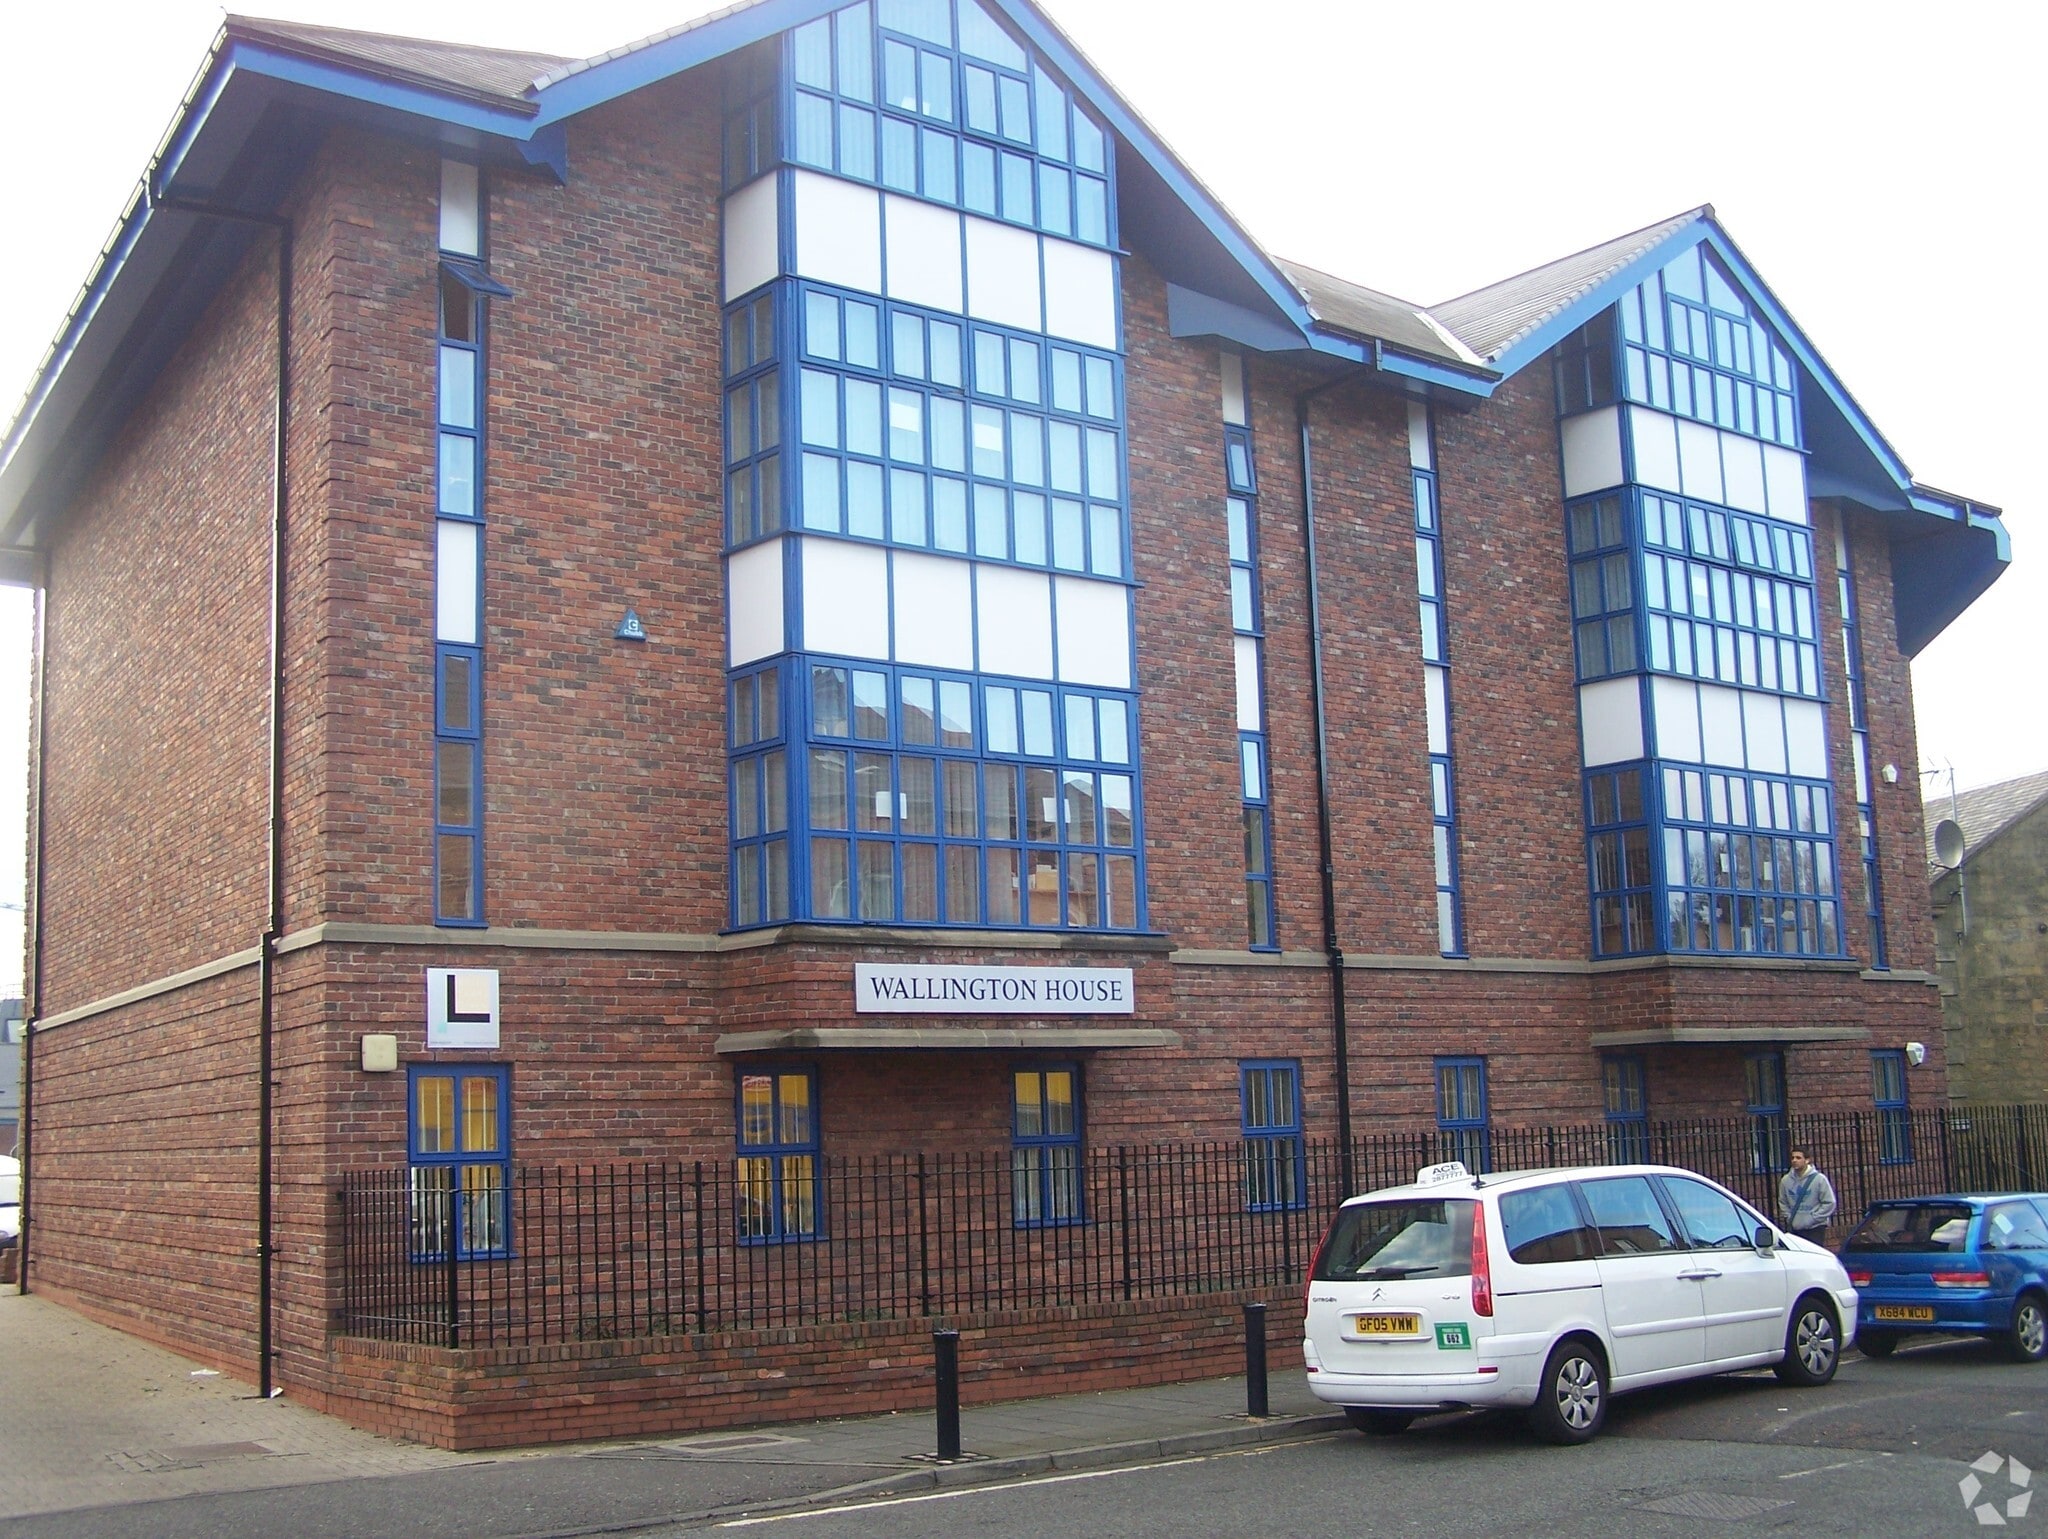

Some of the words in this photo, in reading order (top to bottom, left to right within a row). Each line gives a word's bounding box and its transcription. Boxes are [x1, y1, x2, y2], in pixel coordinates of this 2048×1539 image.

[870, 976, 1037, 1001] WALLINGTON
[1045, 979, 1123, 1002] HOUSE
[1432, 1163, 1460, 1175] ACE
[1359, 1317, 1388, 1331] GF05
